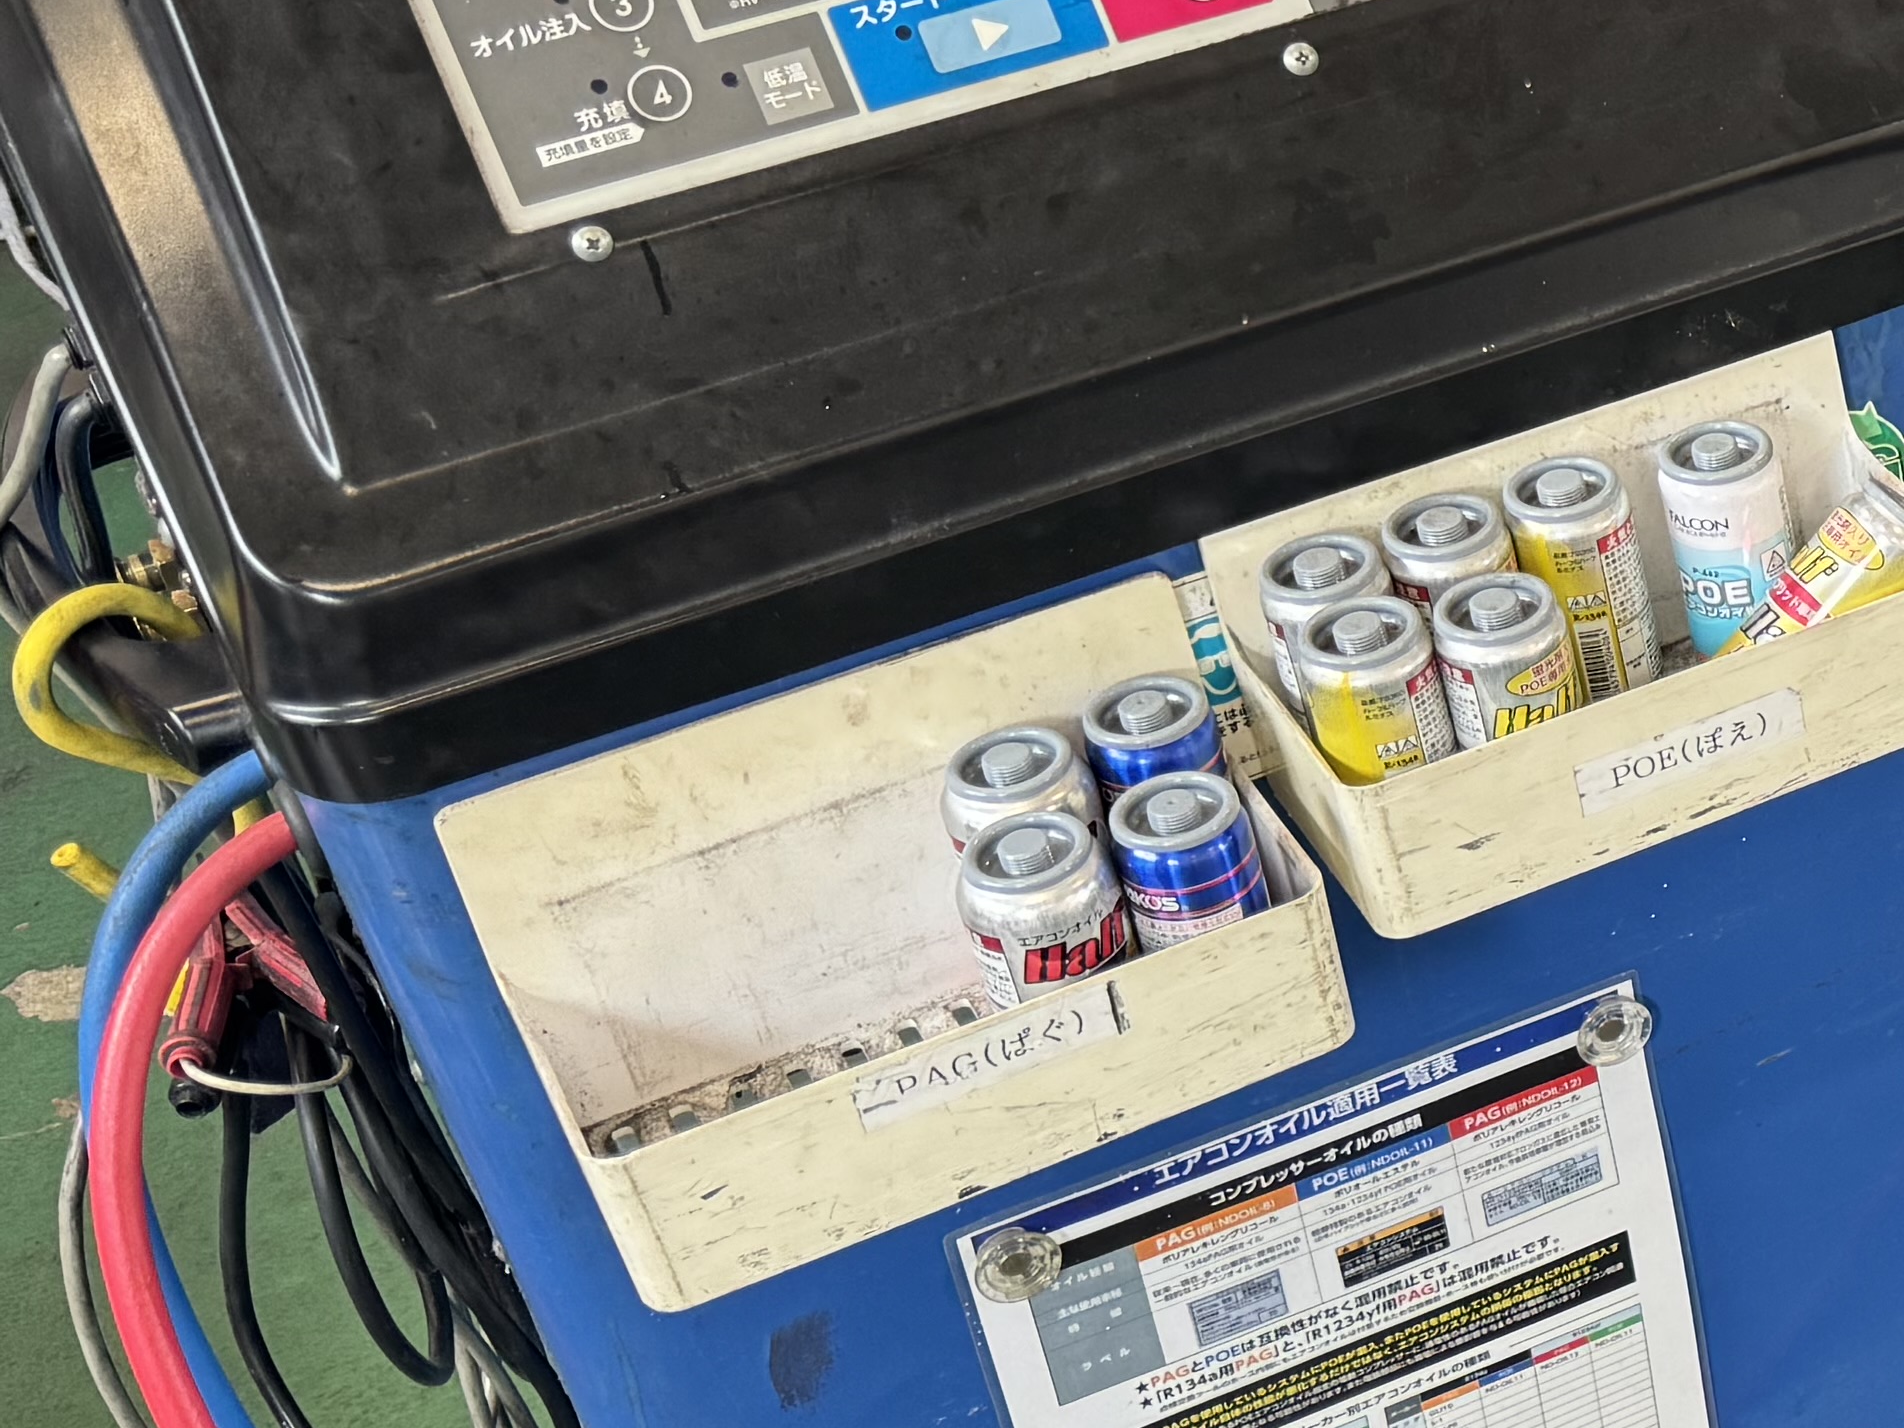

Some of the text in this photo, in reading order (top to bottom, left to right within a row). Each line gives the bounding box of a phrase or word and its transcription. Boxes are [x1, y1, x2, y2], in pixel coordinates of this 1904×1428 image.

[469, 12, 592, 58] オイル注入
[762, 60, 807, 87] 低温
[762, 82, 823, 109] モード
[573, 99, 632, 133] 充填
[1612, 712, 1769, 788] POE(ぽえ)
[1018, 909, 1103, 947] エアコンオイル
[896, 1010, 1084, 1095] PAG(ぱぐ)
[1153, 1053, 1458, 1186] エアコンオイル適用一覧表
[1208, 1112, 1424, 1208] コンプレッサーオイルの種類
